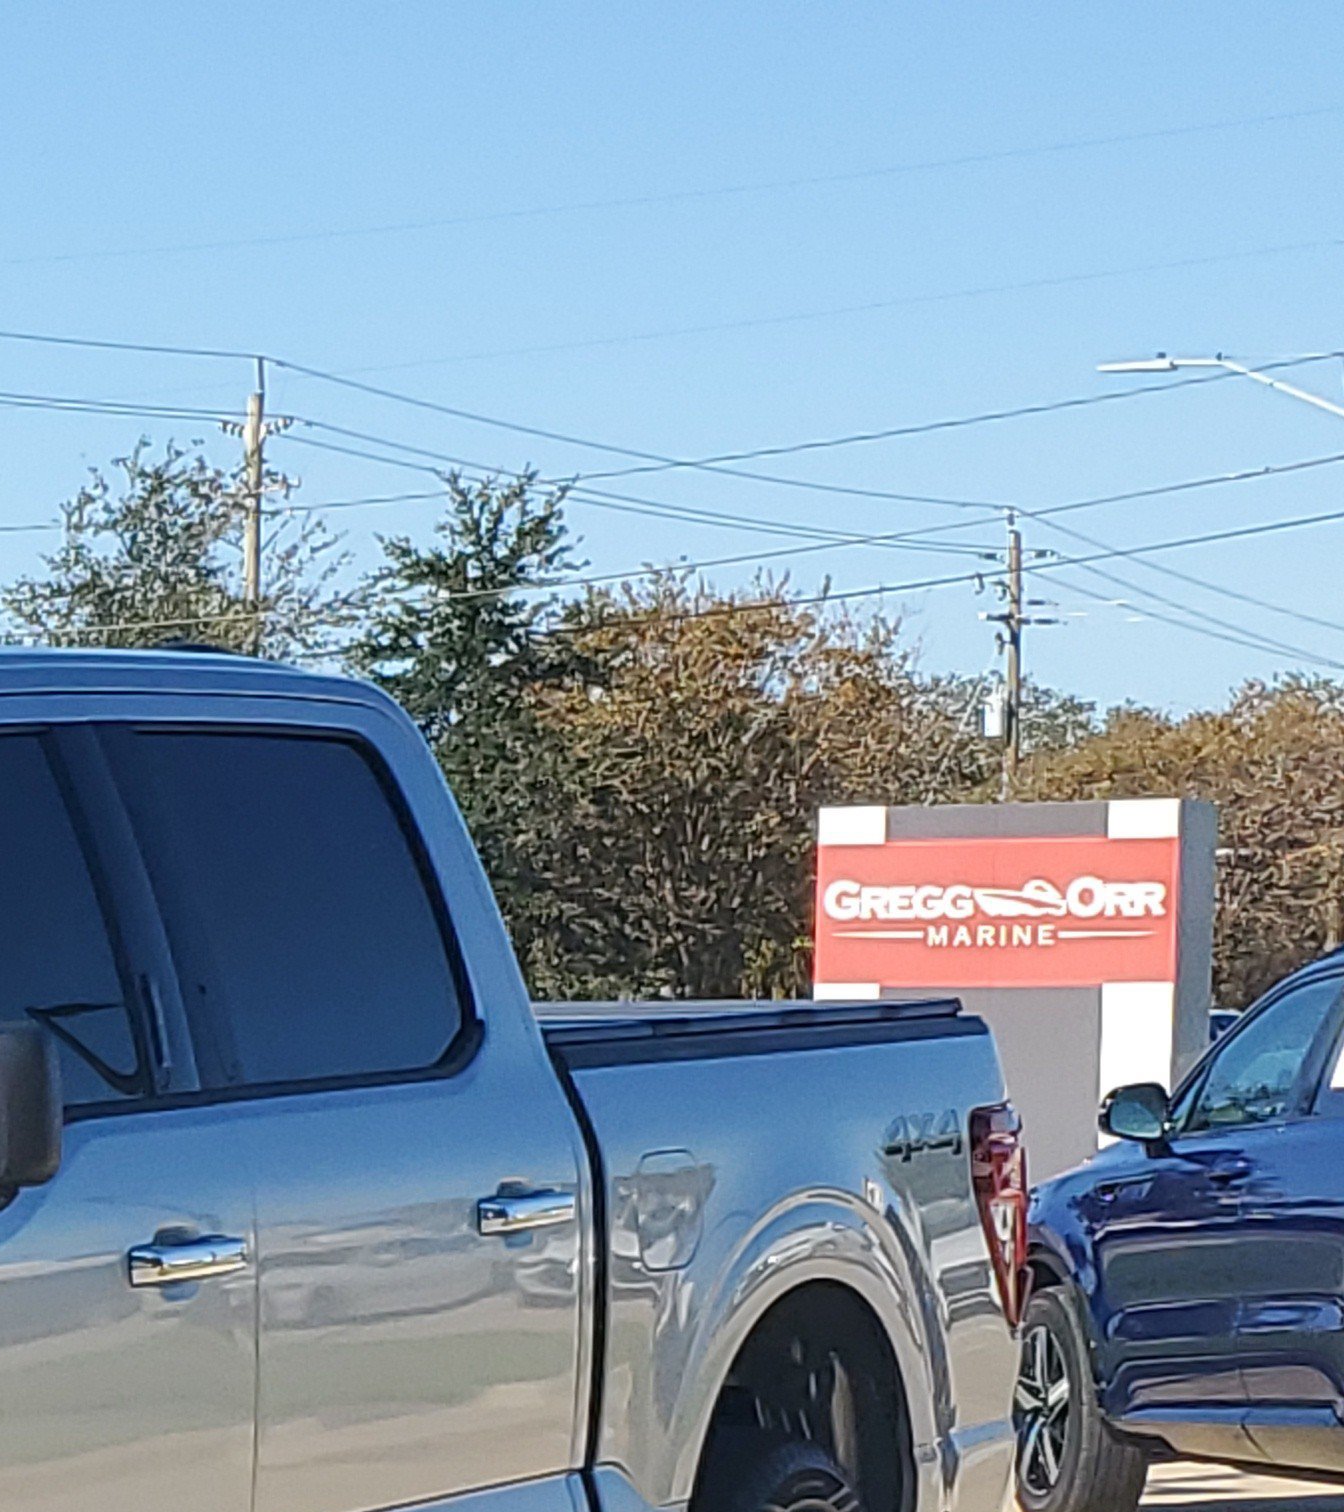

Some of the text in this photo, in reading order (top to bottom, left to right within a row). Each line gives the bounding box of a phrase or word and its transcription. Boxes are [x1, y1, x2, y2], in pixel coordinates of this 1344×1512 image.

[823, 876, 1166, 919] GREGG ORR
[926, 924, 1057, 948] MARINE
